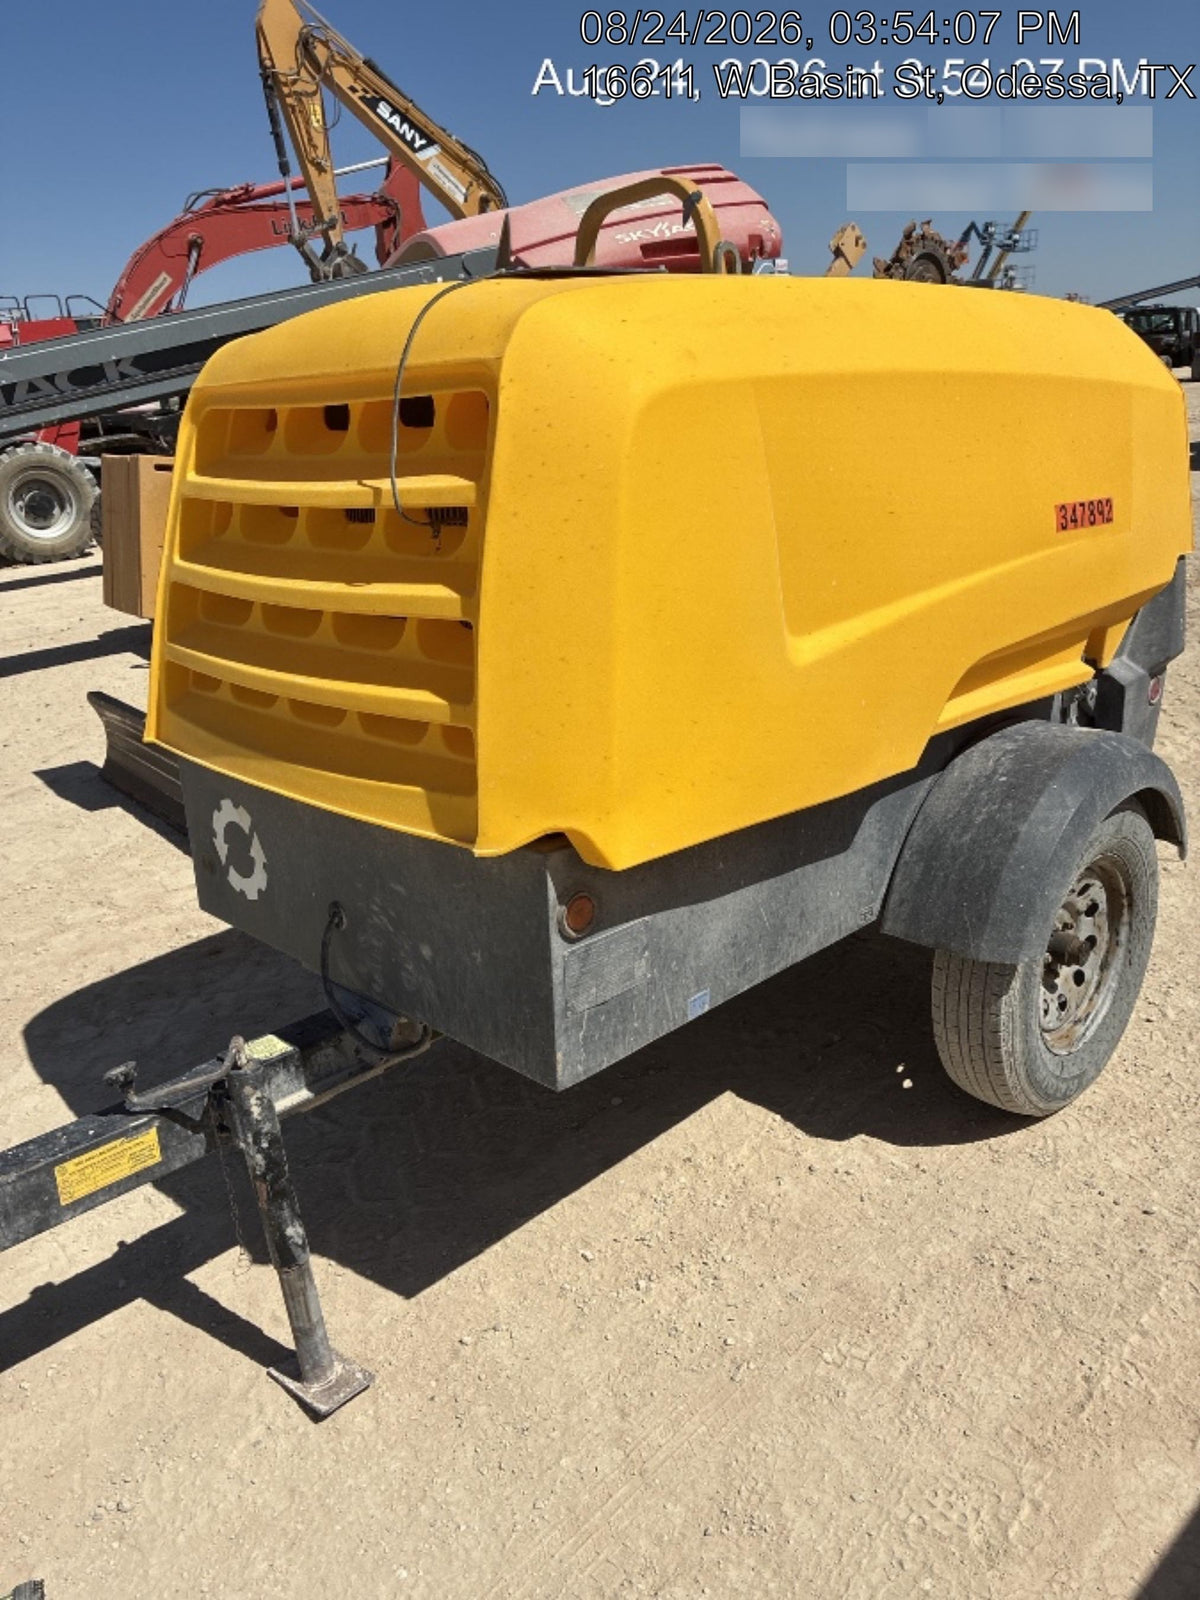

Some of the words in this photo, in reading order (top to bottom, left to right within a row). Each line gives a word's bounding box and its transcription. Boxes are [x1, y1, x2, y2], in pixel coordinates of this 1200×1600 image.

[376, 100, 428, 149] SANY
[0, 357, 146, 405] ACK
[1059, 497, 1113, 531] 347892
